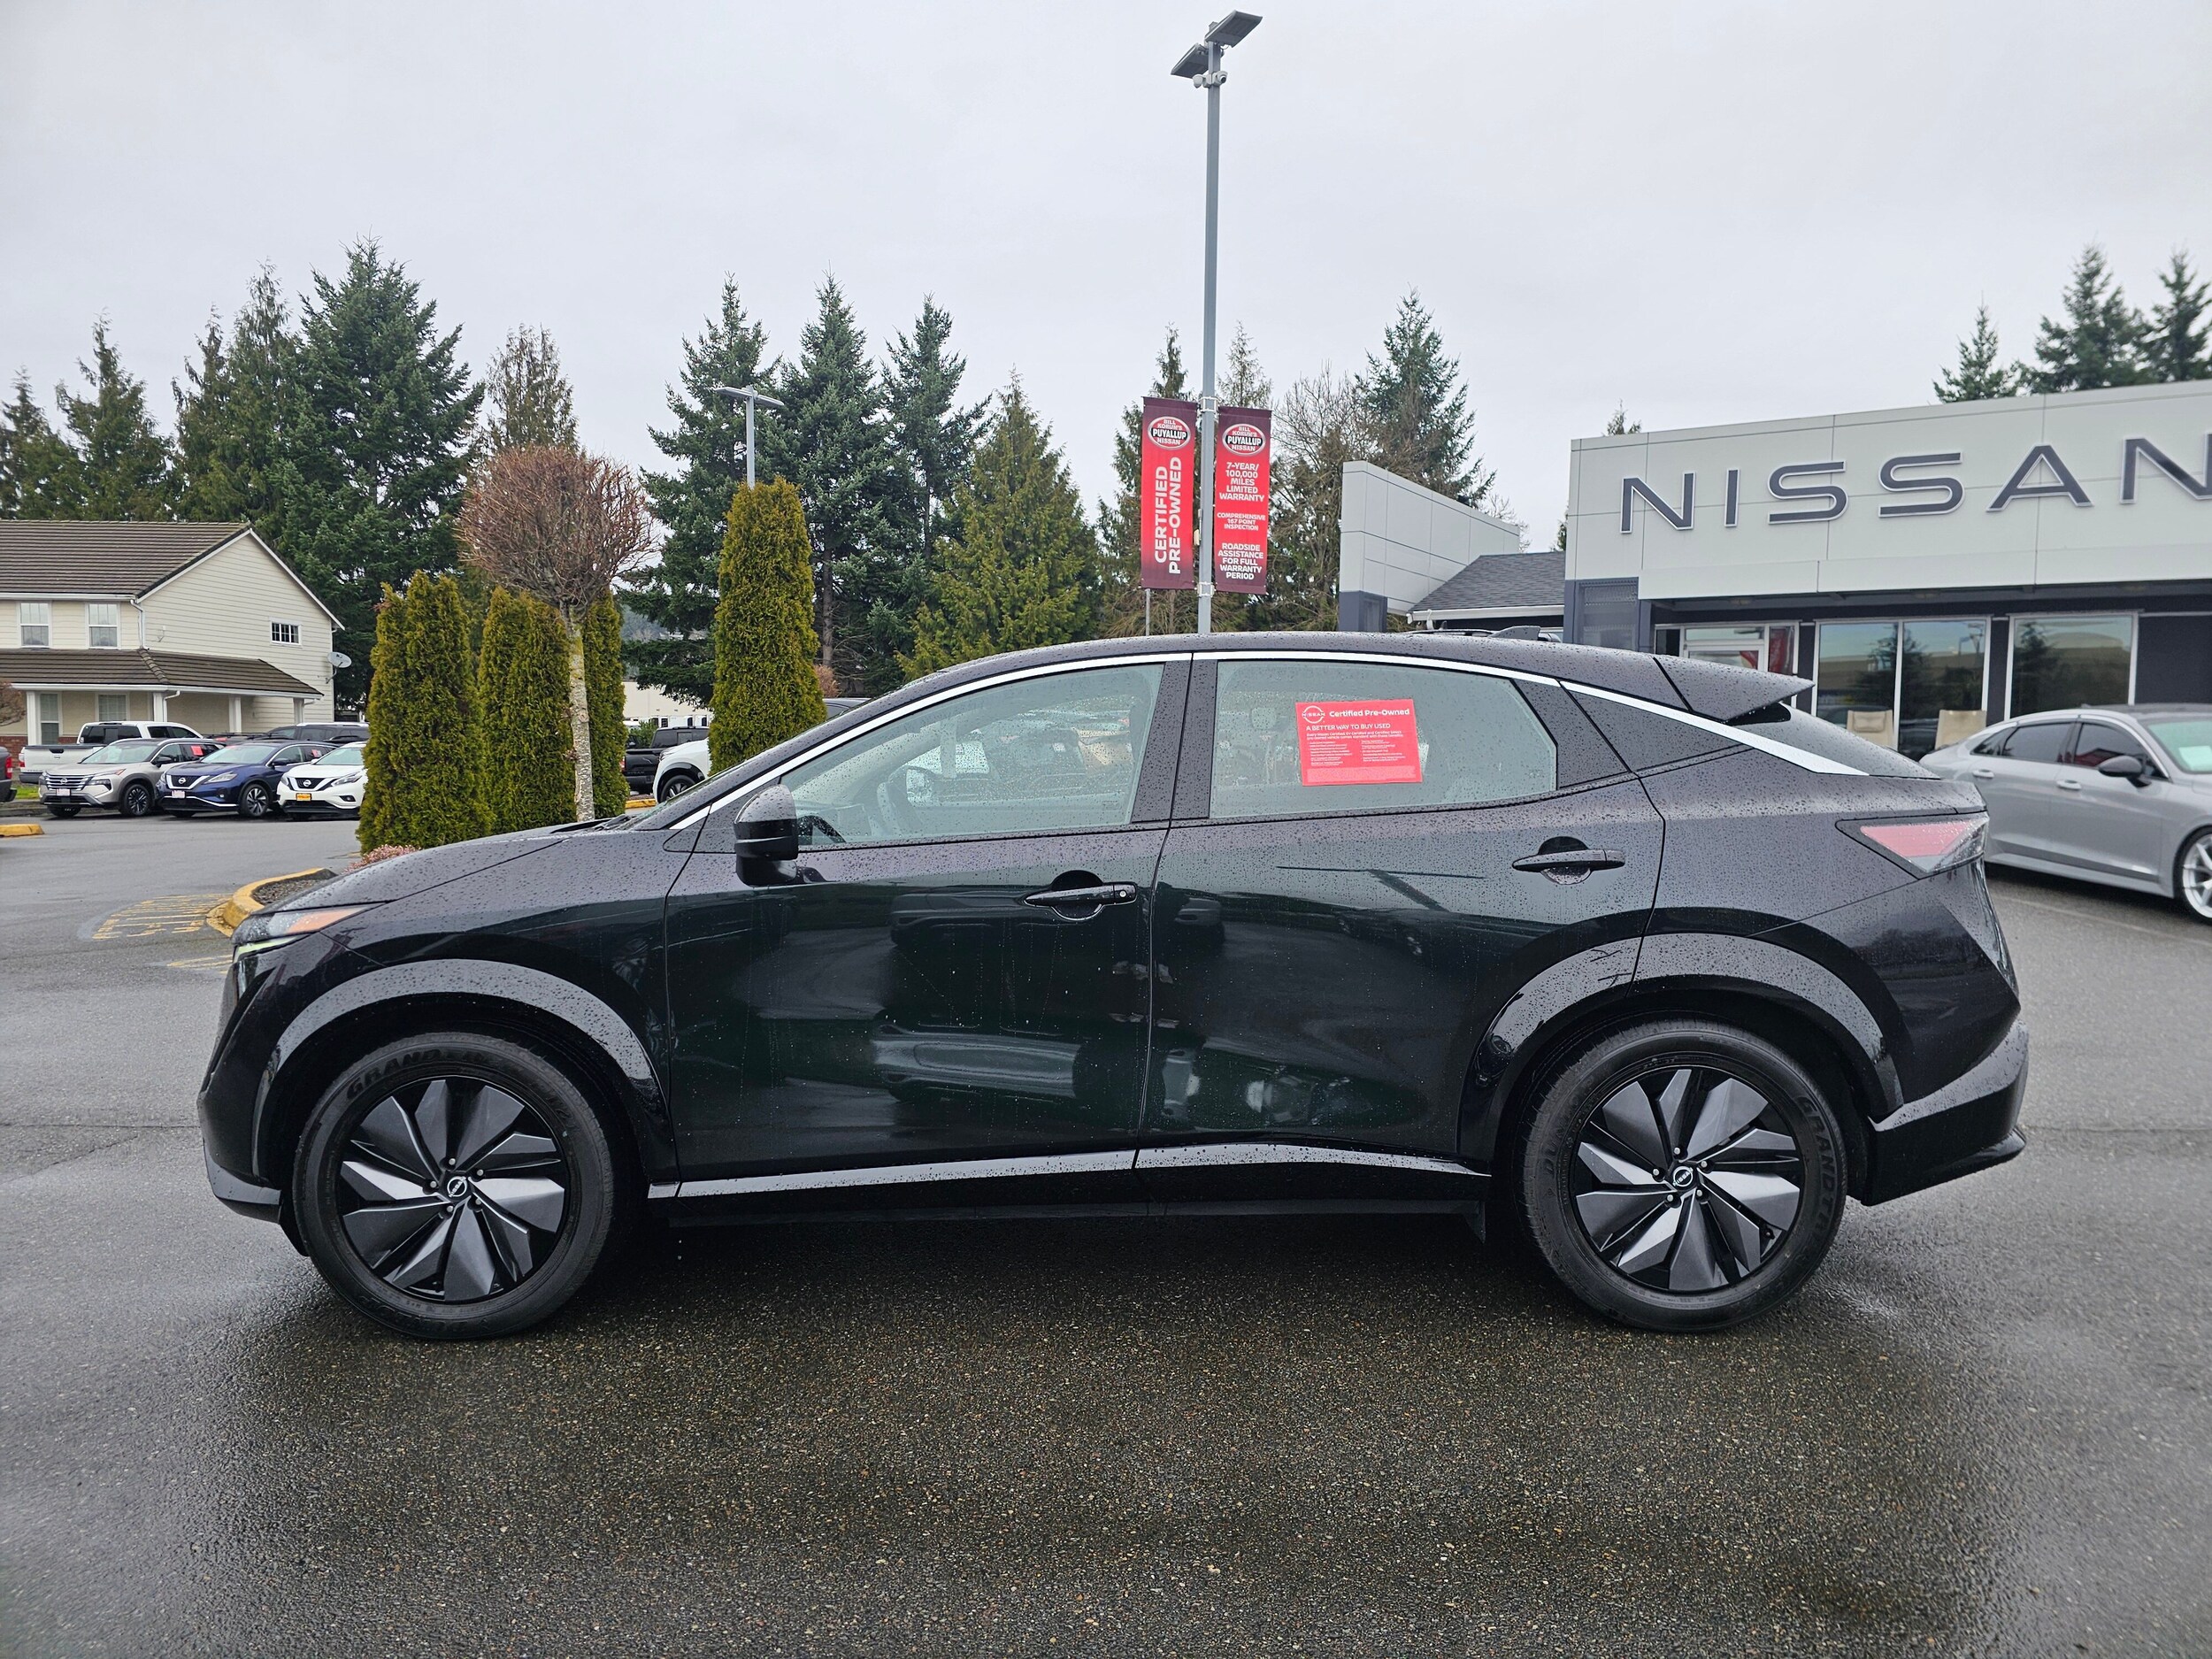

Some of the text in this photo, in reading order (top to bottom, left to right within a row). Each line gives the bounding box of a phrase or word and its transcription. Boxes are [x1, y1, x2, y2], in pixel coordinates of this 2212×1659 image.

[1152, 428, 1187, 439] PUYALLUP
[1227, 436, 1262, 446] PUYALLUP
[1226, 462, 1259, 471] 7-YEAR/
[1225, 470, 1258, 478] 100,000
[1231, 477, 1255, 486] MILES
[1619, 432, 2212, 534] NISSAN
[1226, 485, 1258, 494] LIMITED
[1219, 492, 1264, 502] WARRANTY
[1154, 466, 1167, 563] CERTIFIED
[1168, 457, 1182, 574] PRE-OWNED
[1217, 512, 1266, 521] COMPREHENSIVE
[1222, 543, 1260, 551] ROADSIDE
[1218, 550, 1264, 559] ASSISTANCE
[1220, 564, 1262, 573] WARRANTY
[1226, 572, 1255, 580] PERIOD
[1329, 709, 1363, 718] Certified
